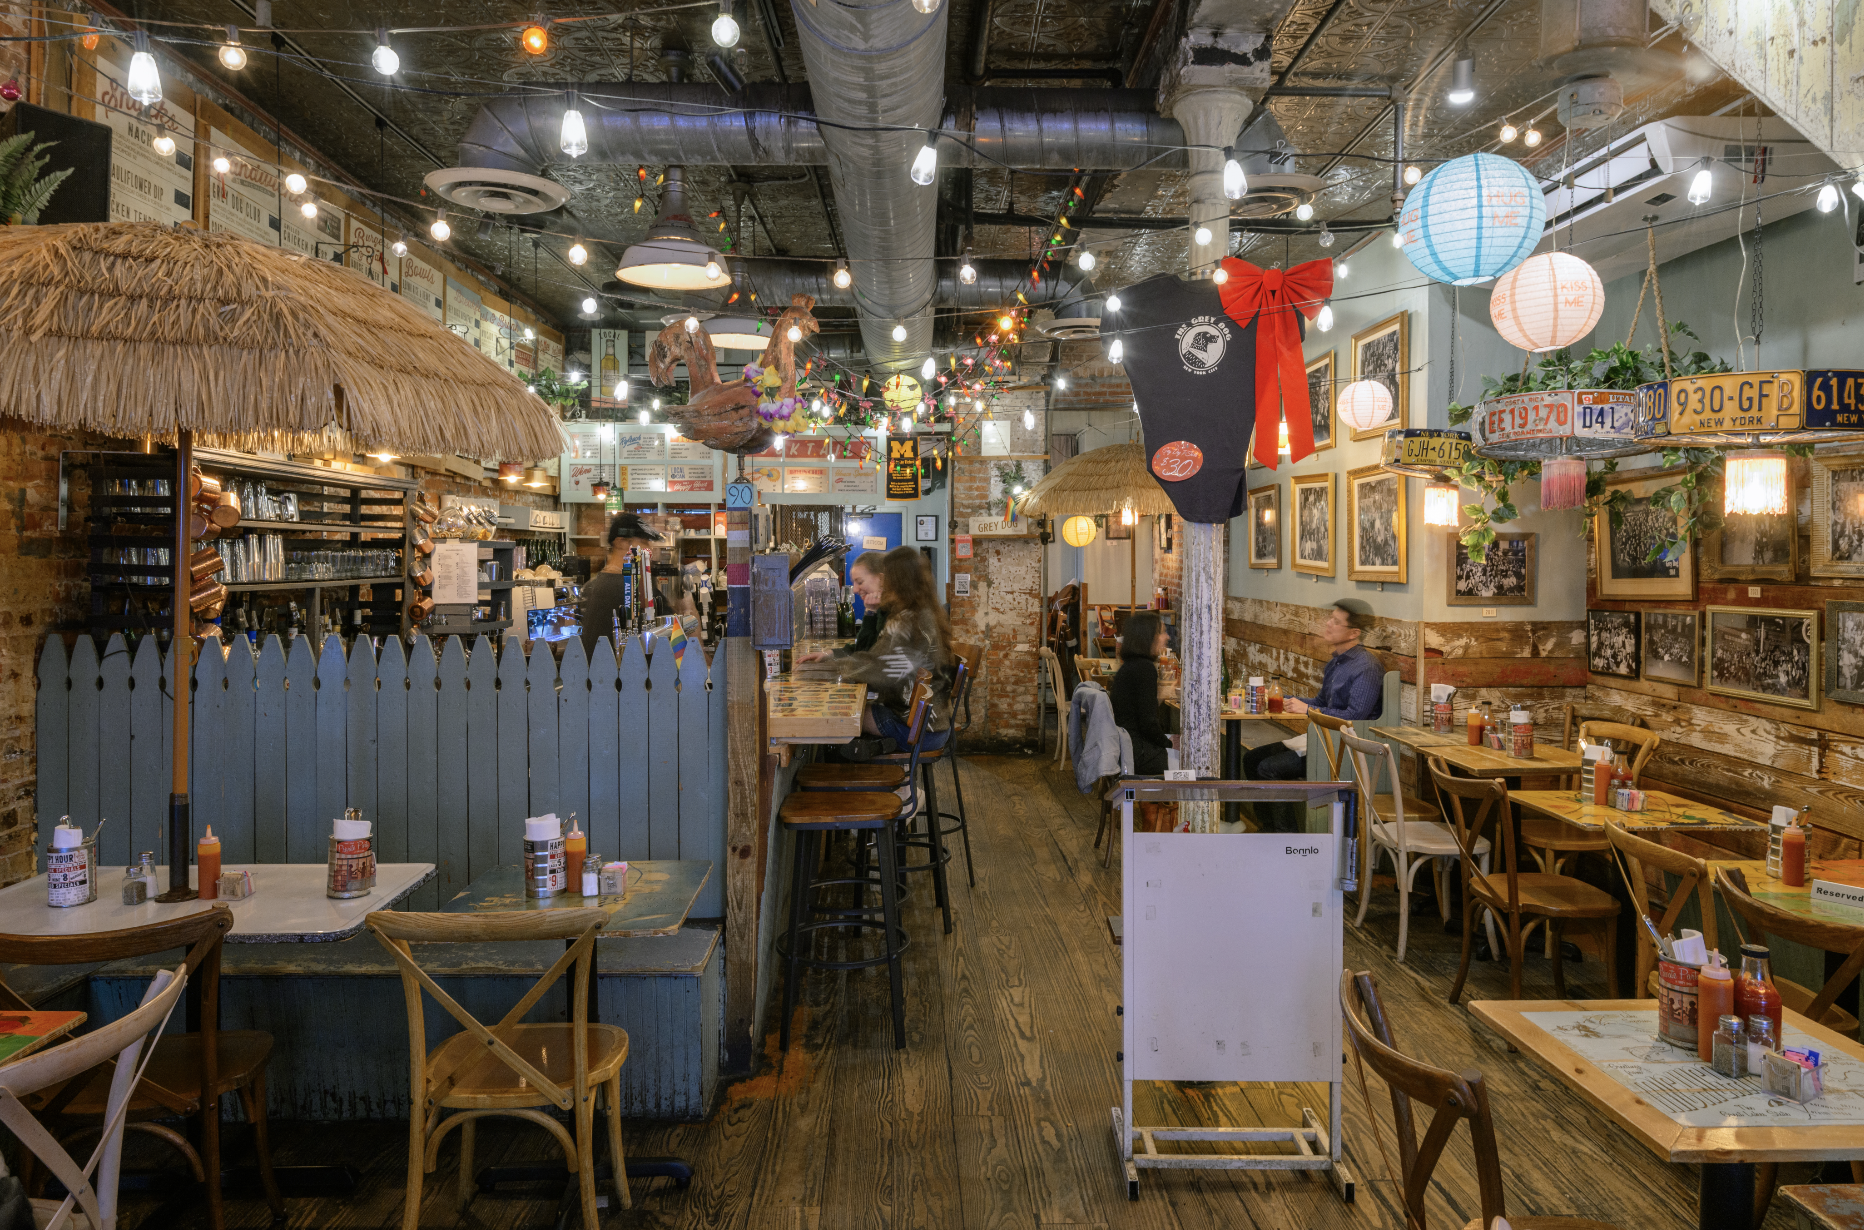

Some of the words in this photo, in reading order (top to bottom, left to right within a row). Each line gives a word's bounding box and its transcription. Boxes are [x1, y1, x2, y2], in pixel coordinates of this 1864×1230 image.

[101, 77, 179, 131] Snaks
[111, 163, 152, 197] AULIFLOWER
[154, 184, 164, 201] DIP
[1487, 191, 1526, 206] HUG
[1493, 211, 1520, 226] ME
[405, 258, 436, 285] Bowls
[1560, 281, 1588, 293] KISS
[1564, 296, 1585, 307] ME
[1191, 315, 1217, 325] GREY
[1218, 322, 1233, 341] DOG
[1504, 397, 1526, 407] COSTA
[1528, 396, 1545, 404] RICA
[1676, 378, 1794, 416] 930-GFB
[1699, 417, 1725, 428] NEW
[1731, 415, 1763, 426] YORK
[1837, 413, 1859, 424] NEW
[1440, 431, 1461, 440] YORK
[890, 440, 915, 458] M
[571, 465, 593, 478] Wine
[728, 485, 753, 505] 90
[978, 521, 999, 533] GREY
[1001, 520, 1018, 530] DOG
[54, 854, 74, 864] HOUR
[1816, 887, 1864, 902] Reserved
